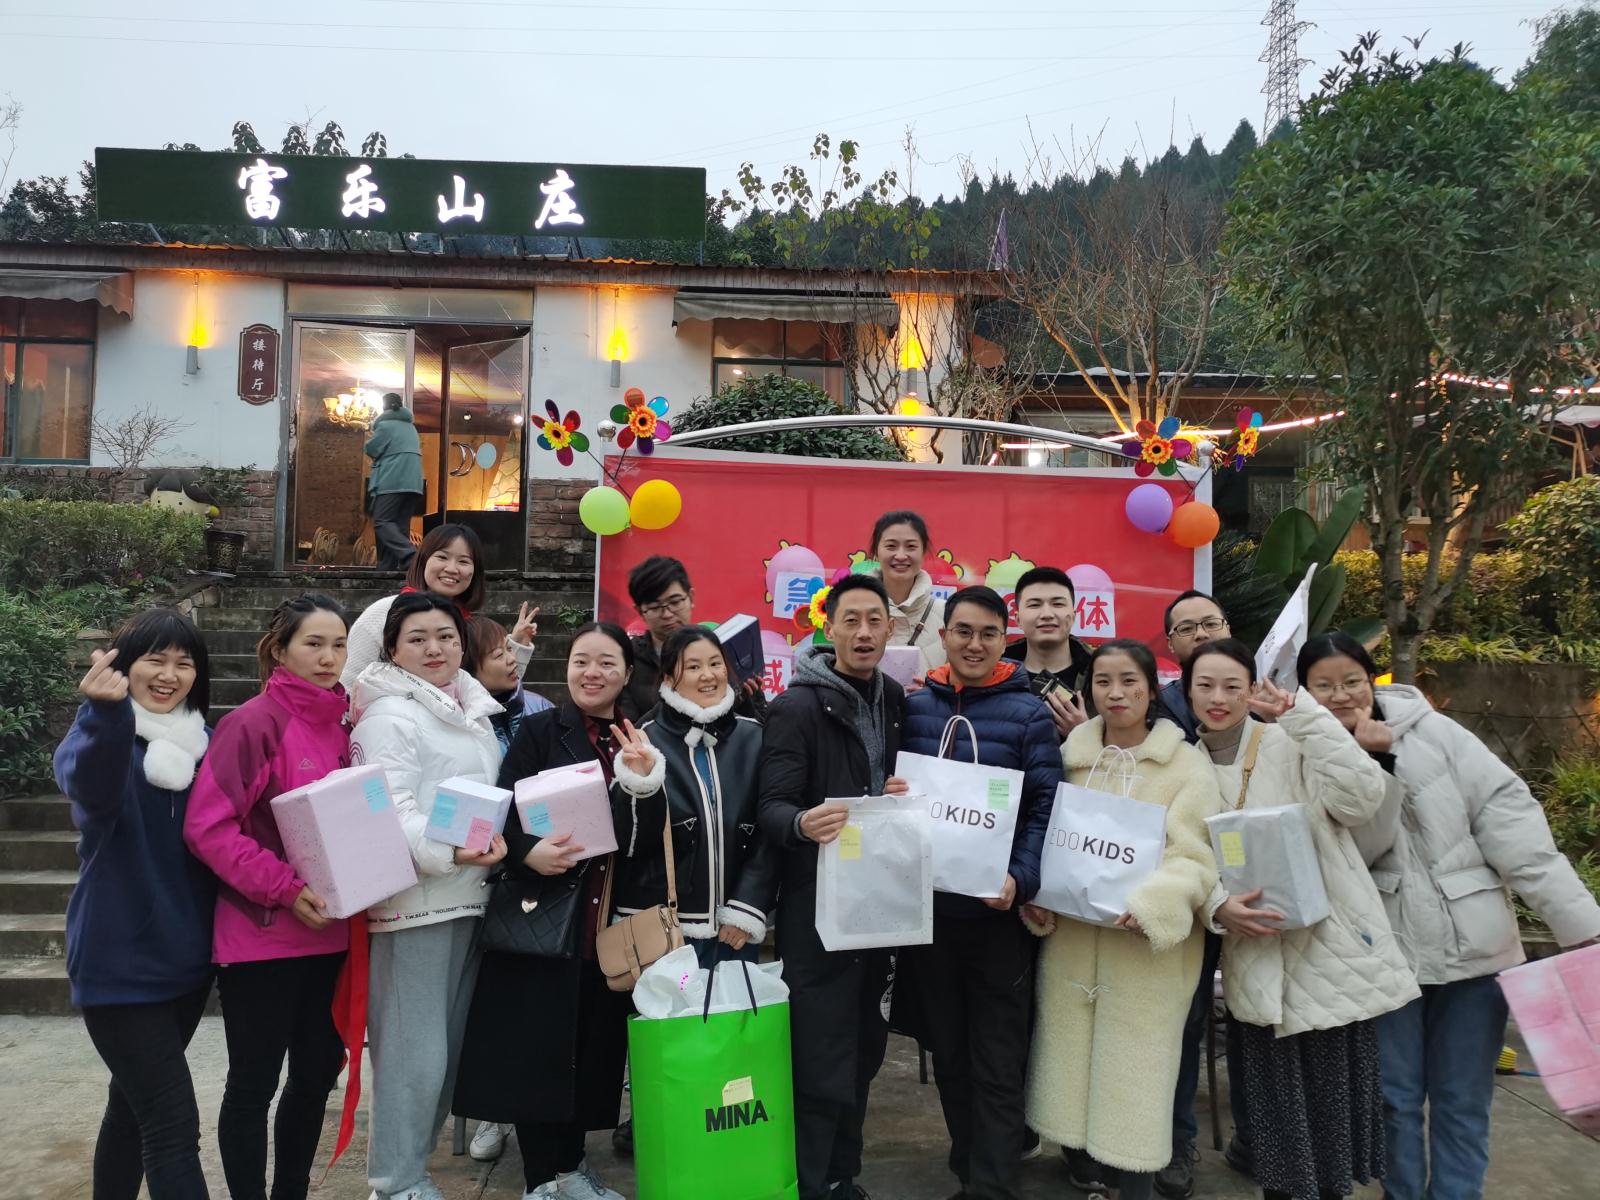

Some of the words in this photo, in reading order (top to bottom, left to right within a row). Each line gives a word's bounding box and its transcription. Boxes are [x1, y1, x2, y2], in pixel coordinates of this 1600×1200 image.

[237, 157, 586, 230] 富乐山庄
[251, 338, 267, 392] 接待厅
[705, 1100, 769, 1133] MINA
